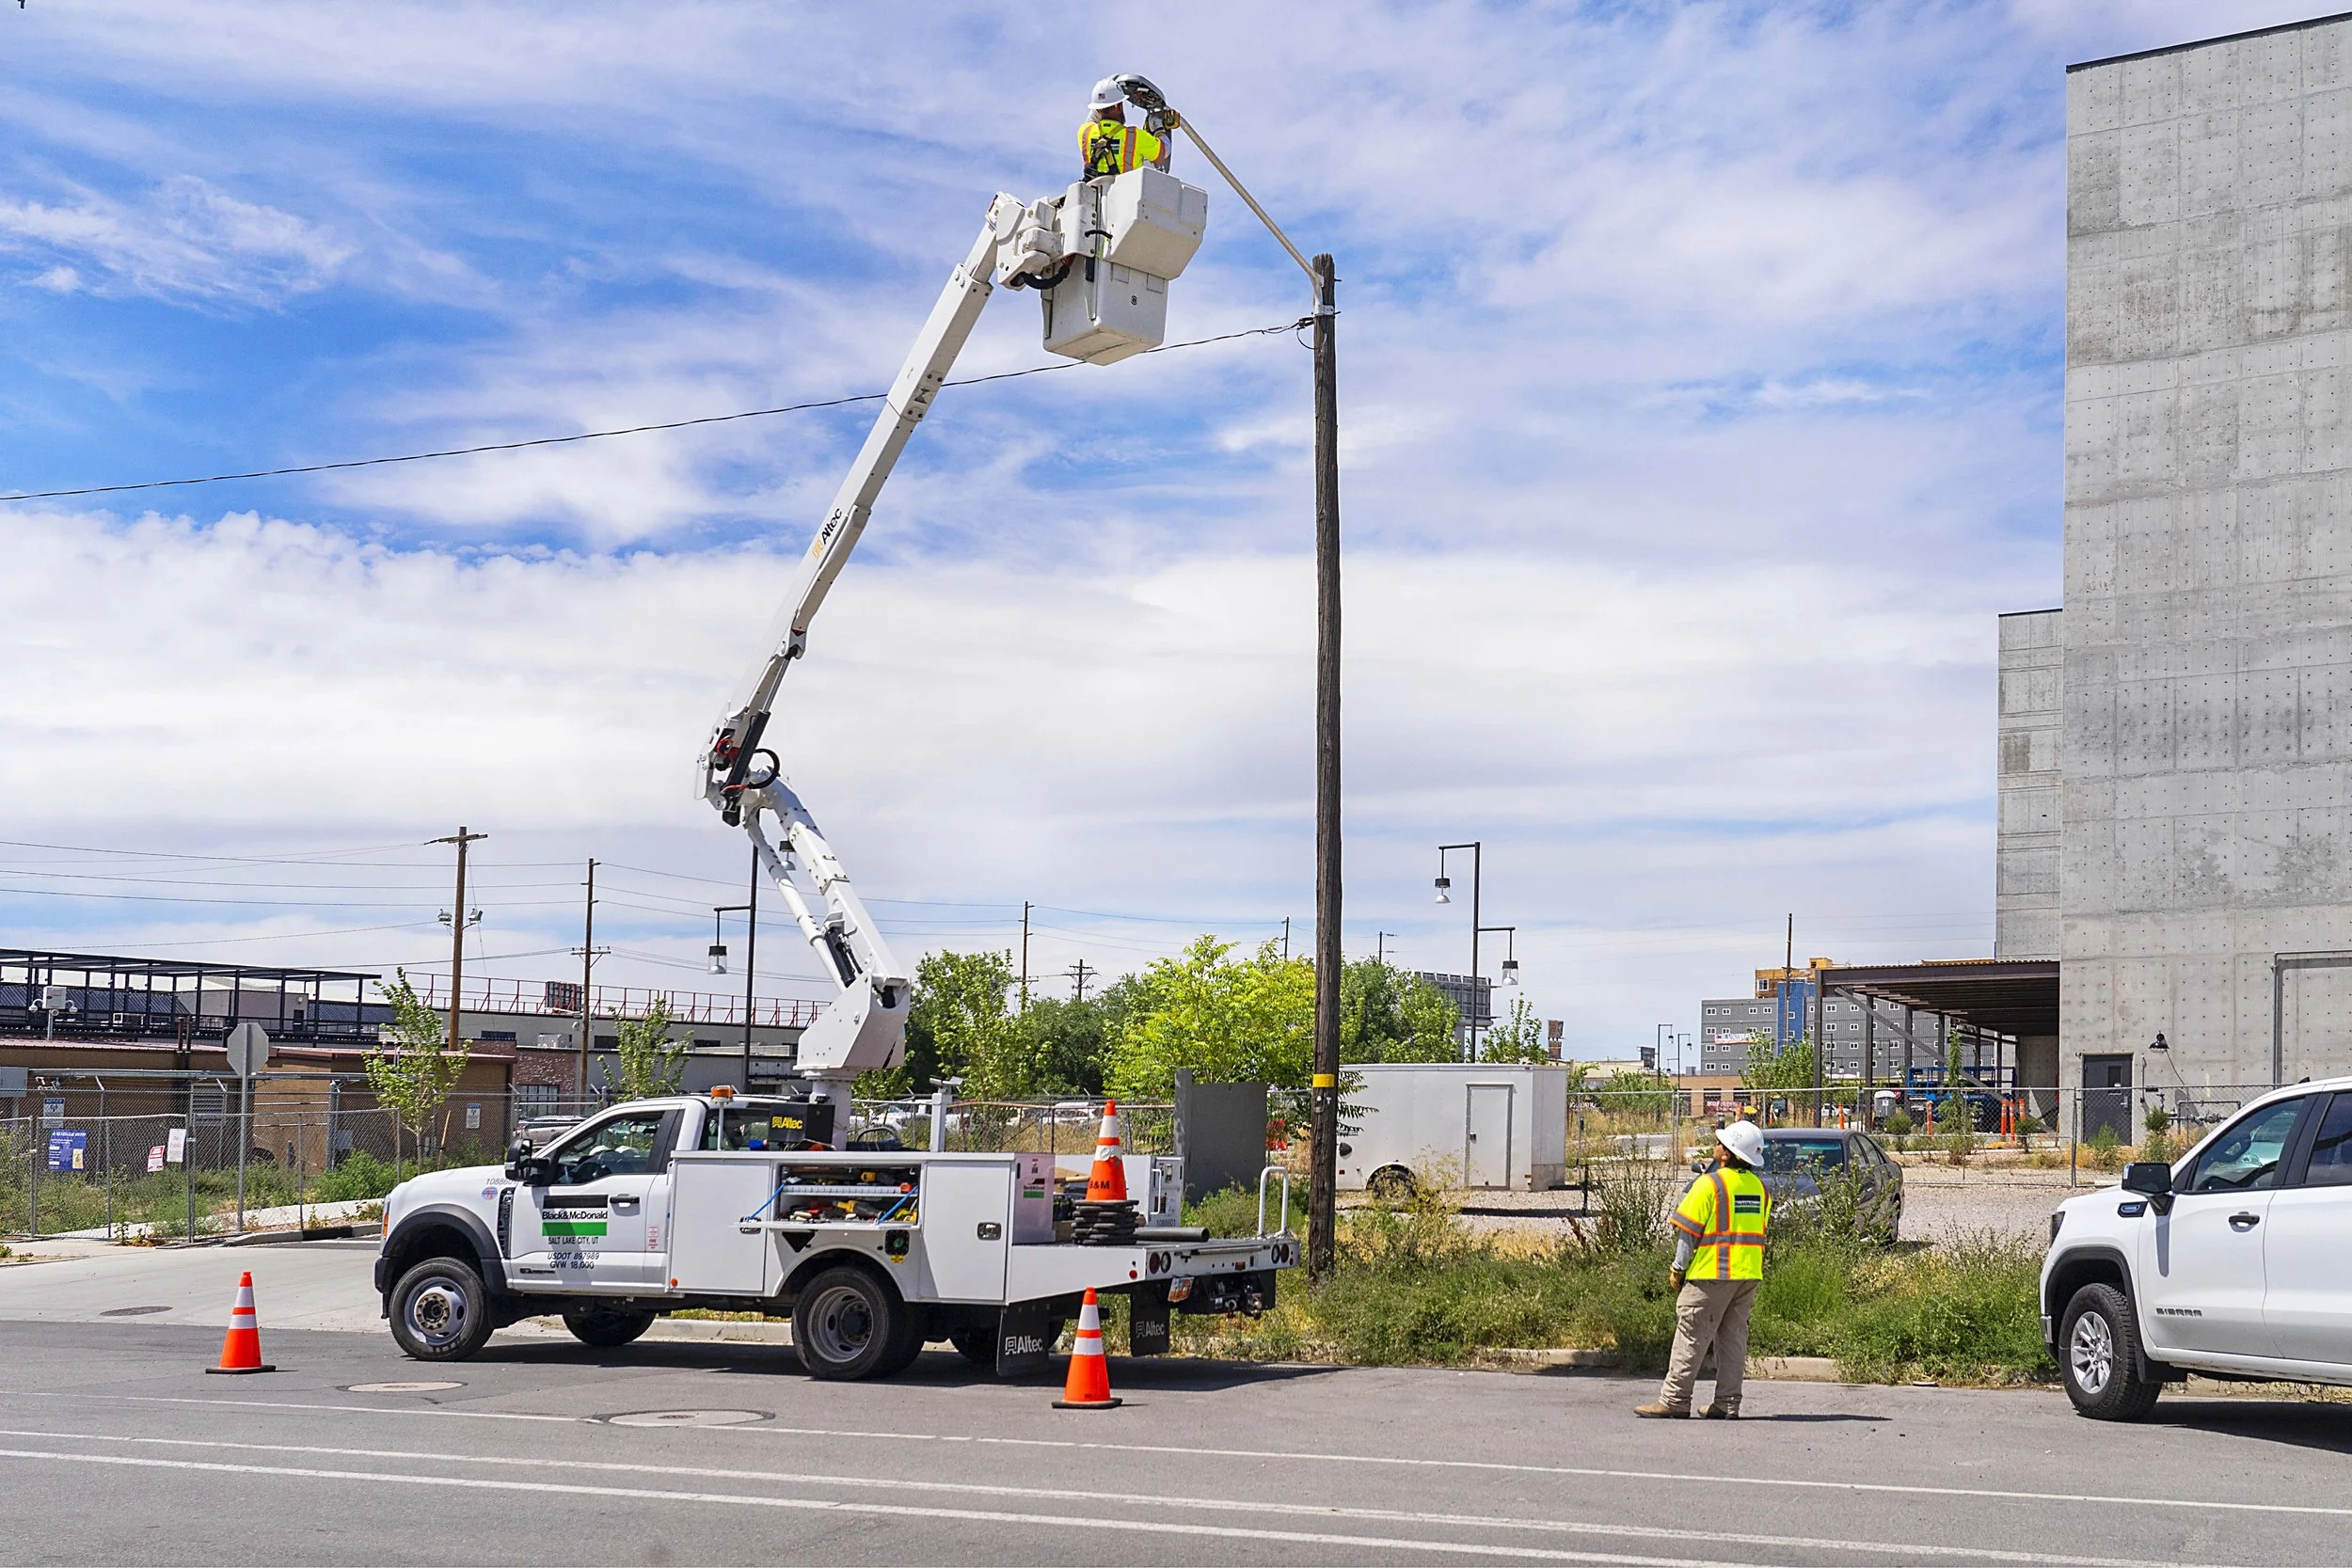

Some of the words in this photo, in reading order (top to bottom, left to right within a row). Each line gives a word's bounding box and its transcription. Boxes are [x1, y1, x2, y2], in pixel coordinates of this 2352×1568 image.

[821, 508, 842, 545] Altec
[782, 1117, 803, 1129] Altec
[542, 1211, 608, 1220] Black&McDonald
[570, 1261, 595, 1270] 18,000
[1145, 1321, 1165, 1336] Altec
[1017, 1335, 1043, 1354] Altec
